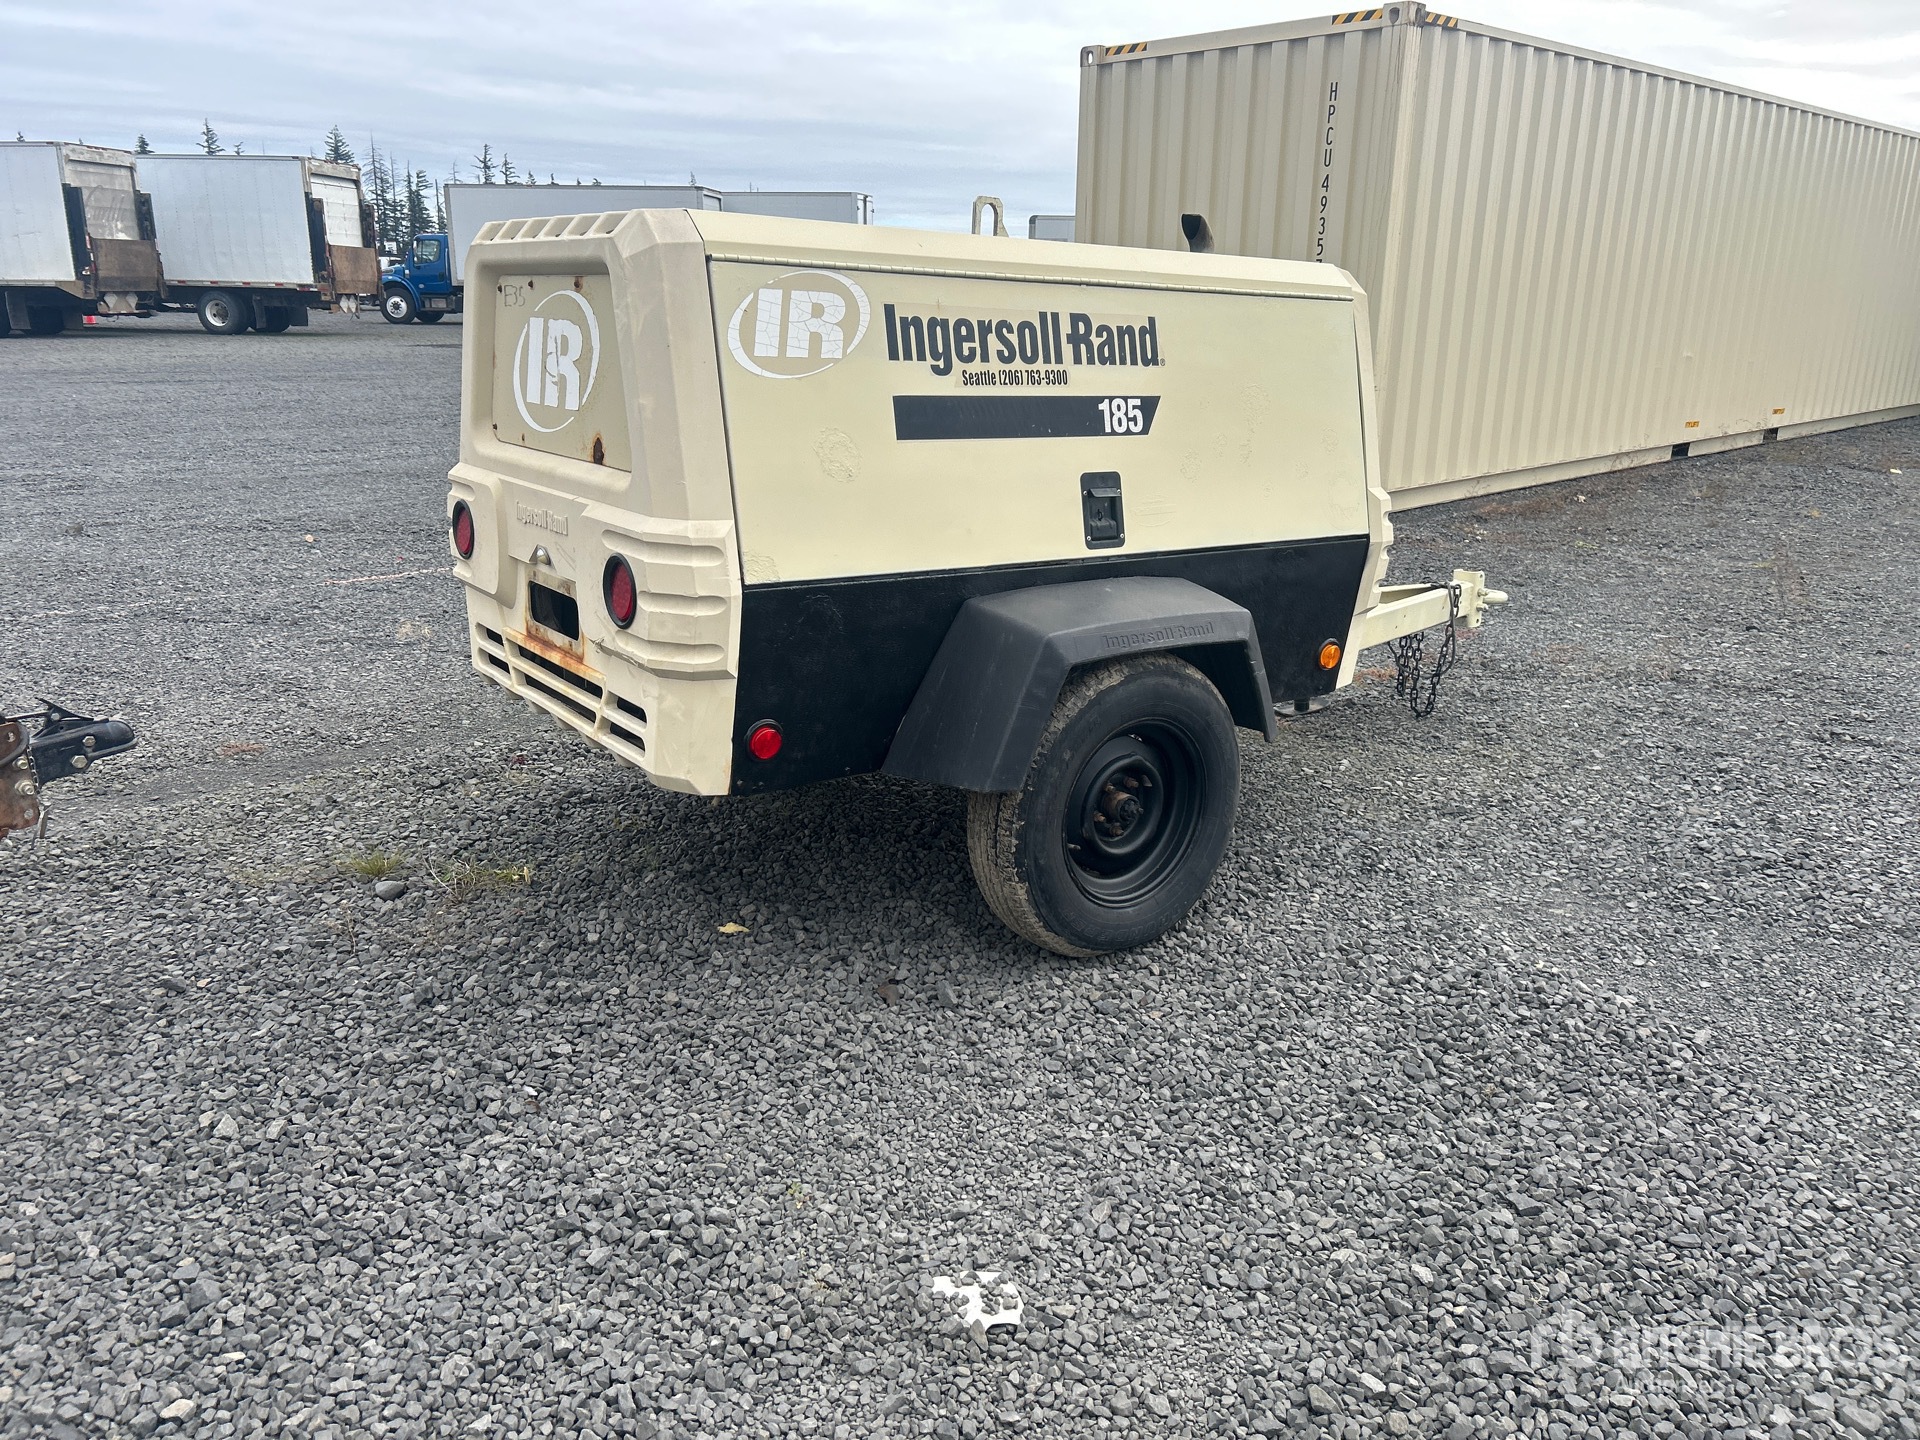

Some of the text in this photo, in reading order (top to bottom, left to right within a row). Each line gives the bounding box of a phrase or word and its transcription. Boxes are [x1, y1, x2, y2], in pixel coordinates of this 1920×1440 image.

[1315, 173, 1330, 263] 4935
[753, 287, 846, 359] IR
[525, 316, 583, 411] IR
[962, 369, 1068, 386] Seattle (206) 763-9300
[1098, 397, 1144, 434] 185
